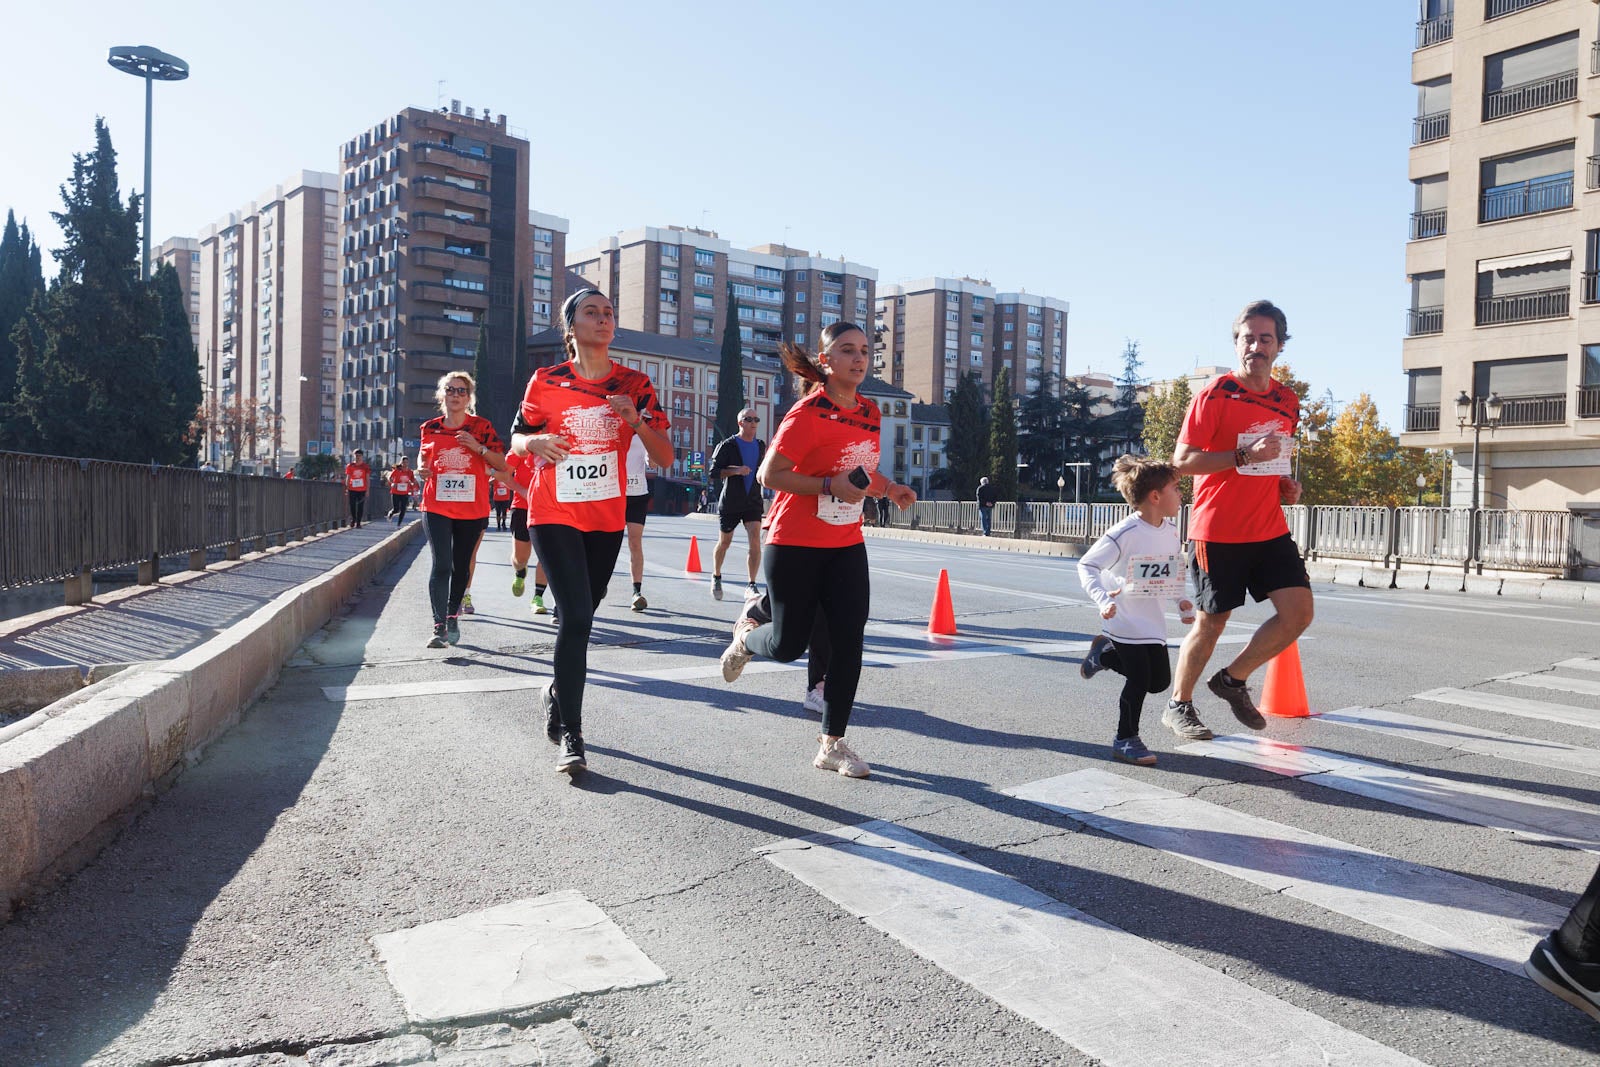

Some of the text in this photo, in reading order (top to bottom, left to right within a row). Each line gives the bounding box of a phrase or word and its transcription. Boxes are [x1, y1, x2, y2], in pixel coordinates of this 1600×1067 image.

[564, 415, 619, 429] carrera
[694, 452, 702, 462] P
[566, 464, 607, 480] 1020
[445, 480, 465, 489] 374
[1140, 563, 1170, 578] 724
